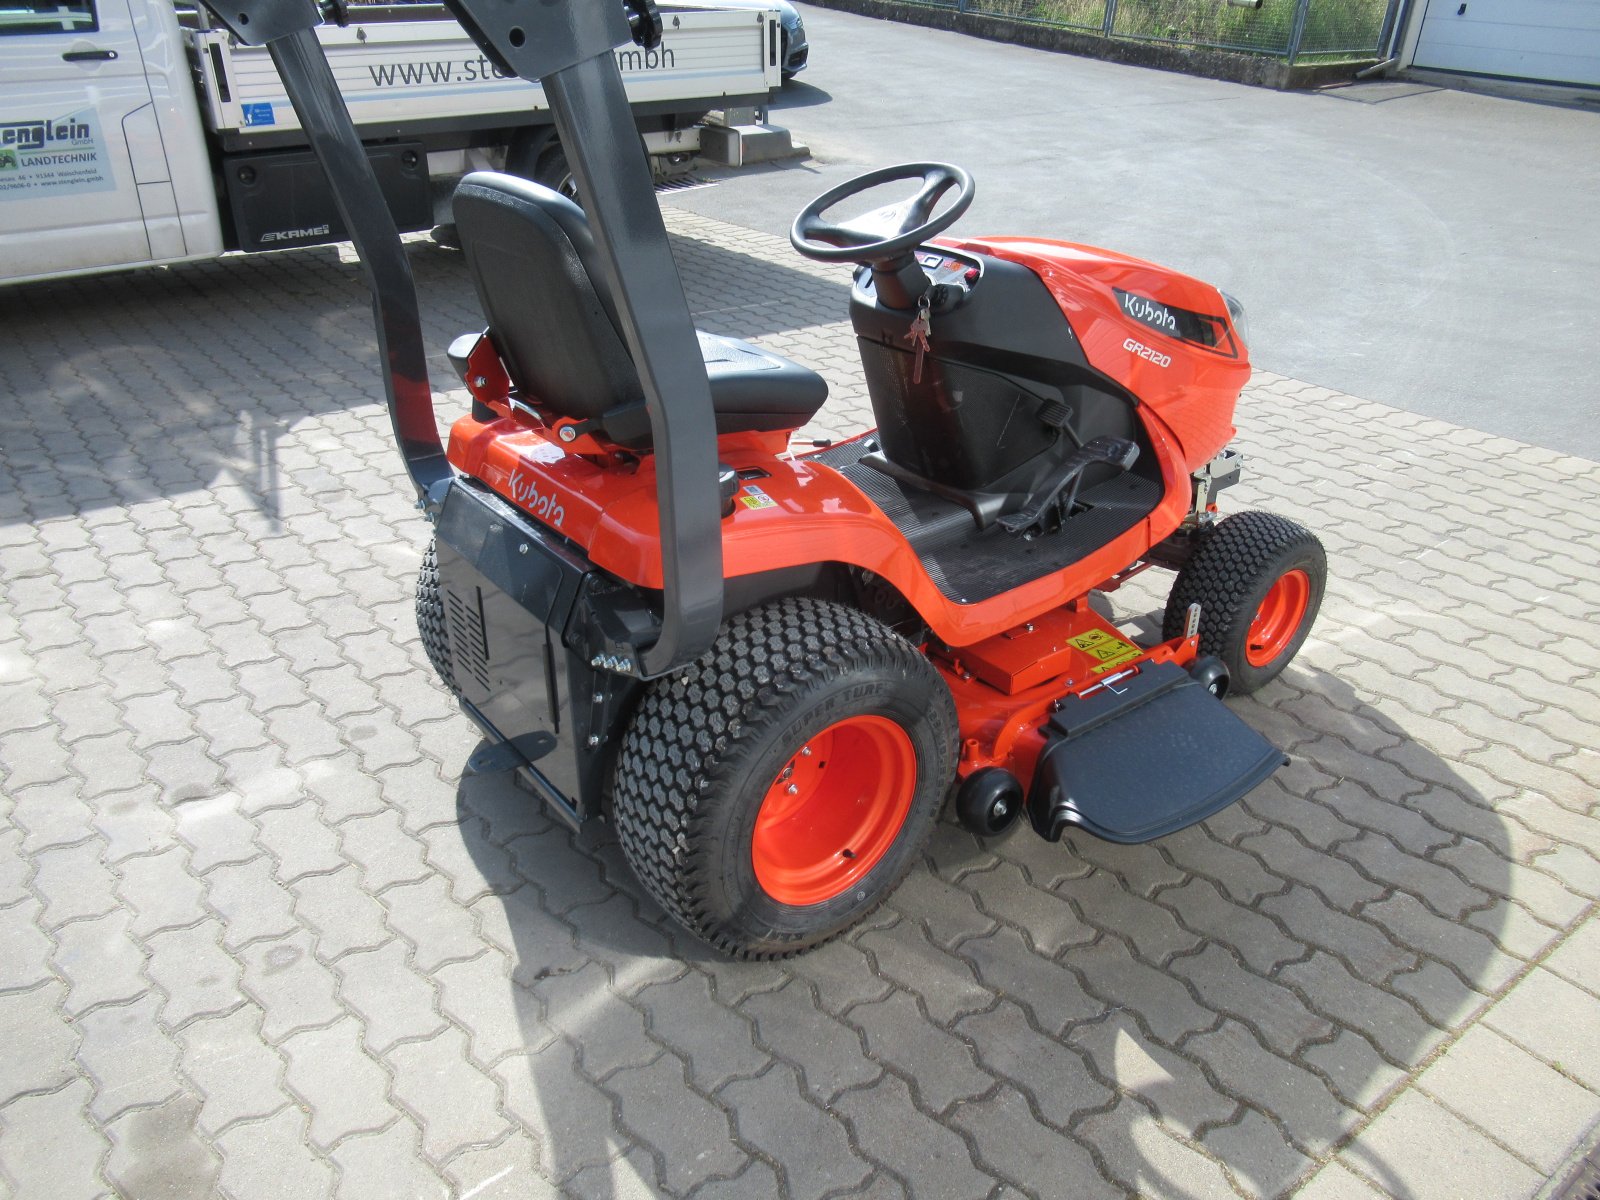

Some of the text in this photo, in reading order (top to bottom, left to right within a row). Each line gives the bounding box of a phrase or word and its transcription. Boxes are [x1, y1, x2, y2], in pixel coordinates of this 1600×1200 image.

[0, 117, 90, 150] englein
[71, 138, 94, 146] GmbH
[21, 152, 97, 167] LANDTECHNIK
[275, 224, 330, 240] KAMEI
[1124, 293, 1176, 331] Kubota
[1122, 338, 1172, 368] GR2120
[508, 469, 565, 527] Kubota
[781, 683, 884, 745] SUPER TURF
